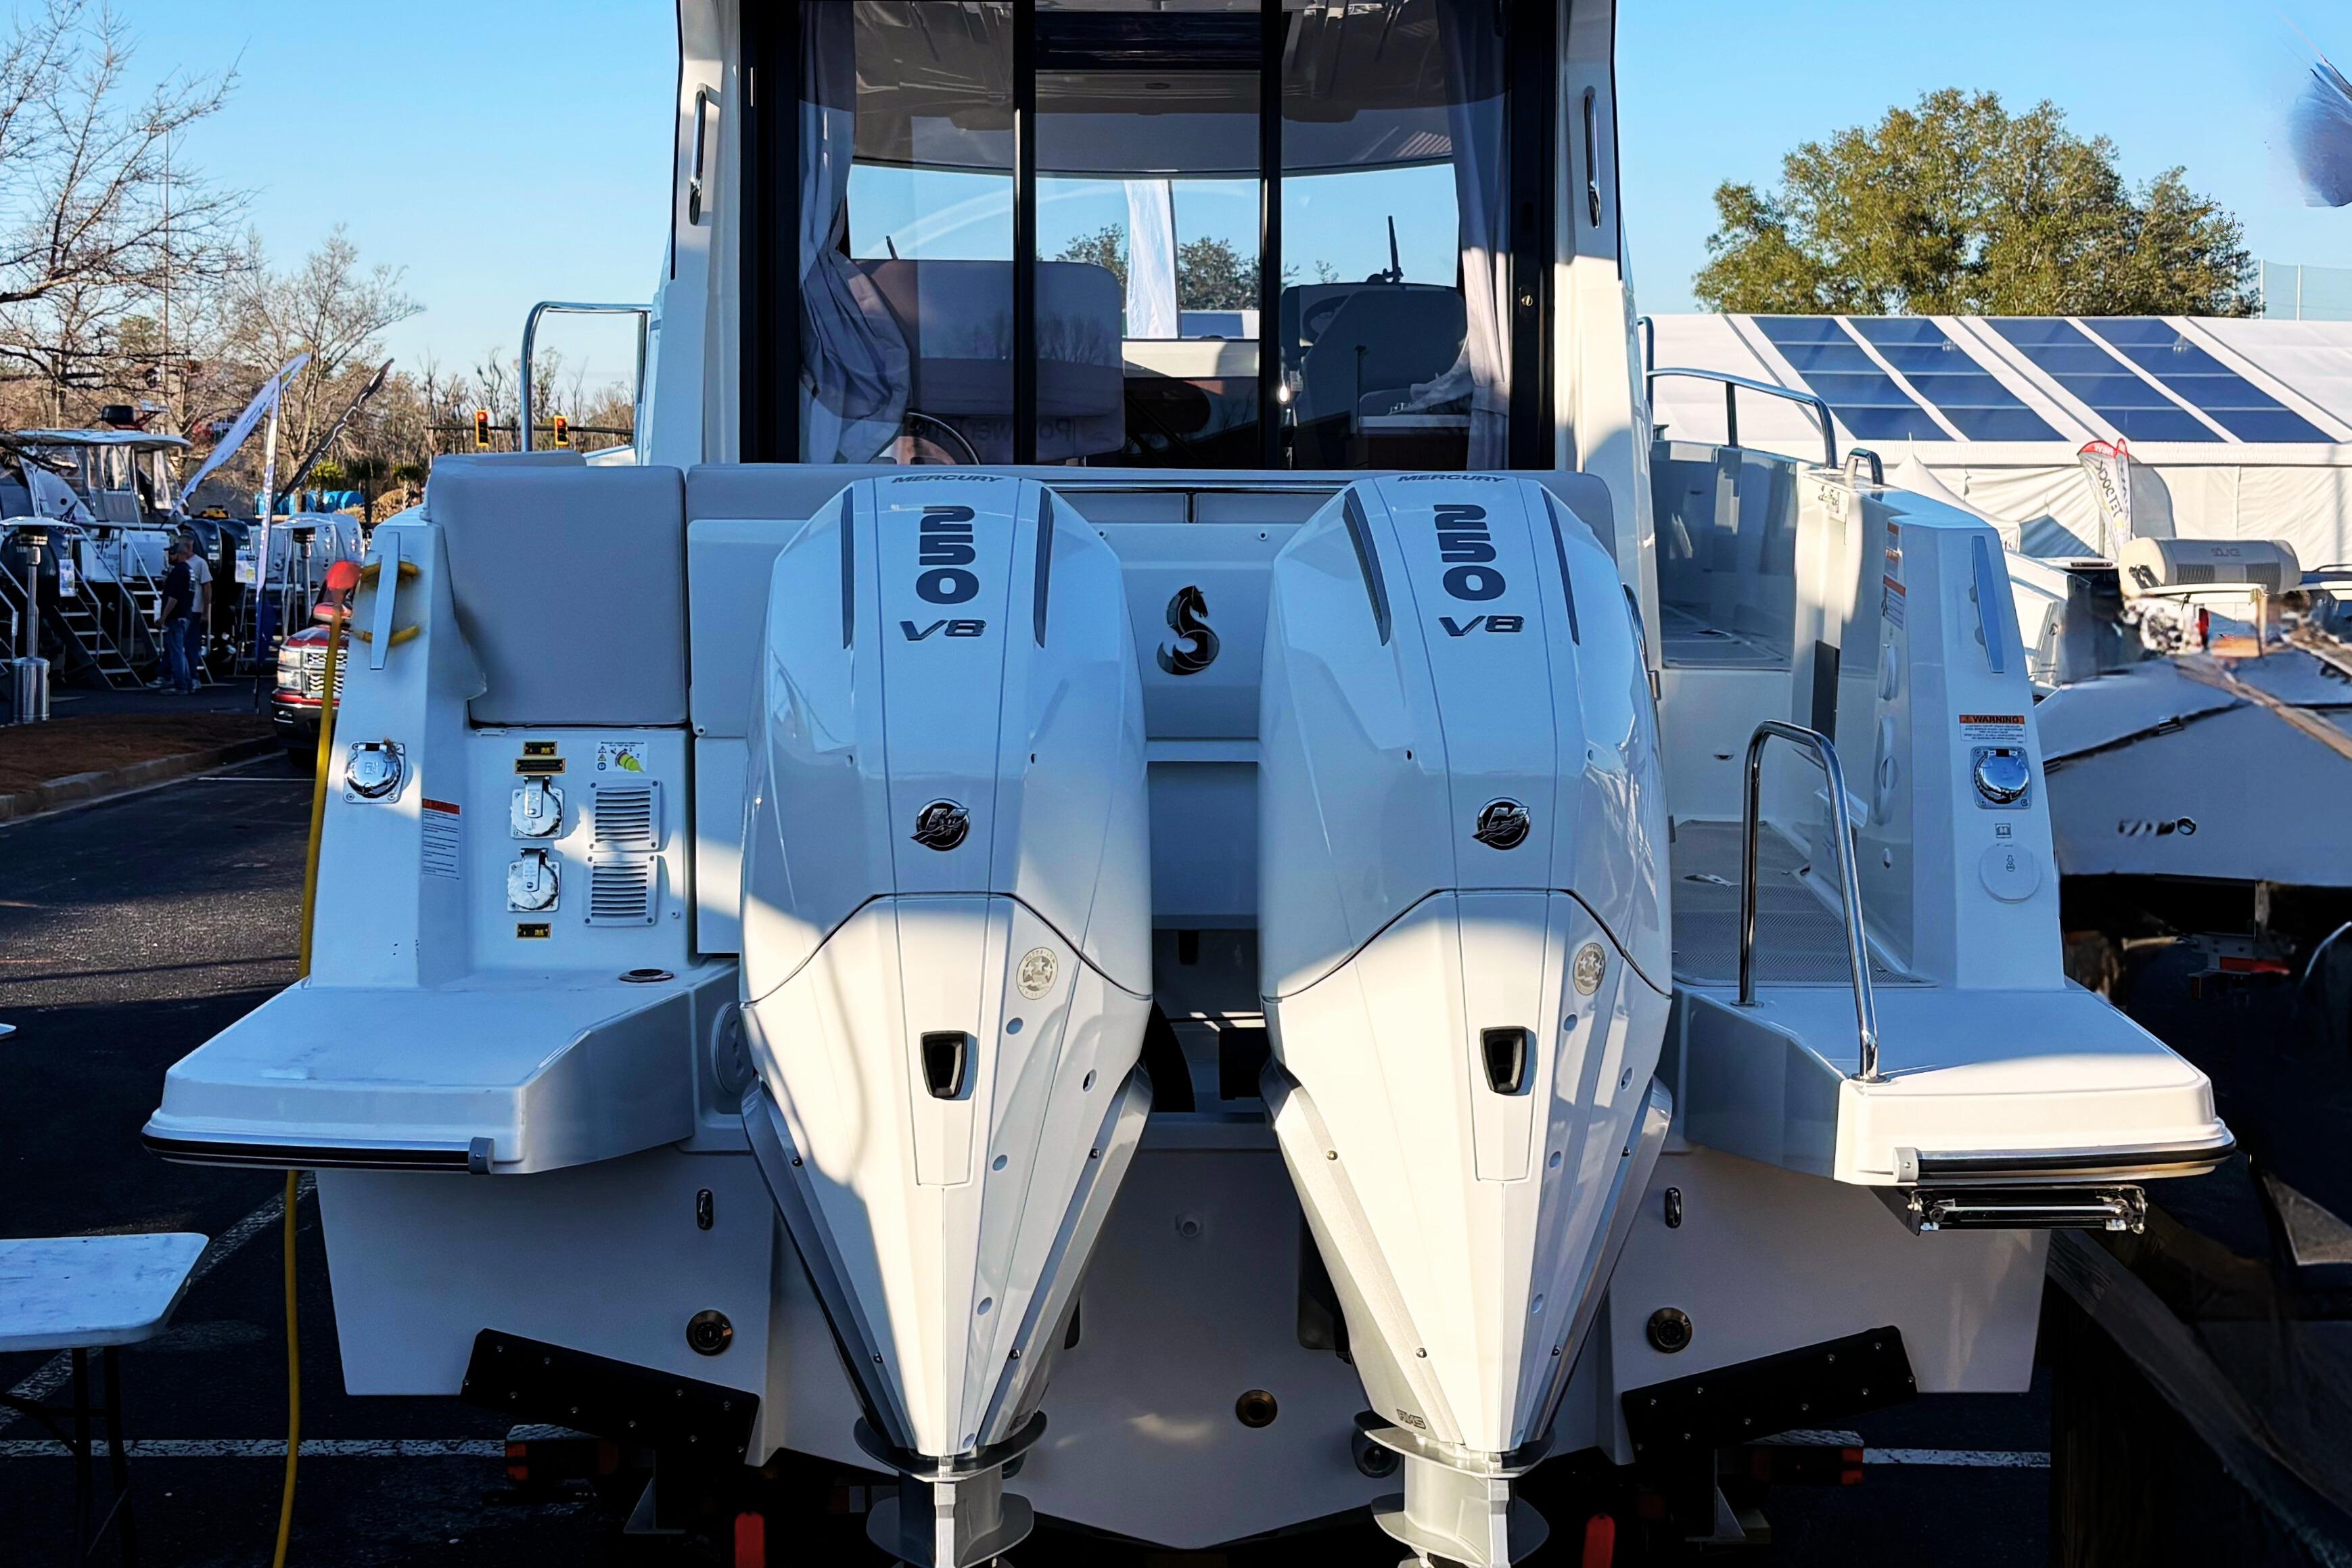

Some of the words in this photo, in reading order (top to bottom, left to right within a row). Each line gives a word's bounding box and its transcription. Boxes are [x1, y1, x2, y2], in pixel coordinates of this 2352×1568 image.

[891, 475, 1004, 484] MERCURY
[1397, 474, 1506, 482] MERCURY
[916, 505, 979, 605] 250
[1433, 504, 1506, 601] 250
[899, 619, 987, 641] V8
[1438, 615, 1525, 637] V8
[1972, 715, 2020, 724] WARNING
